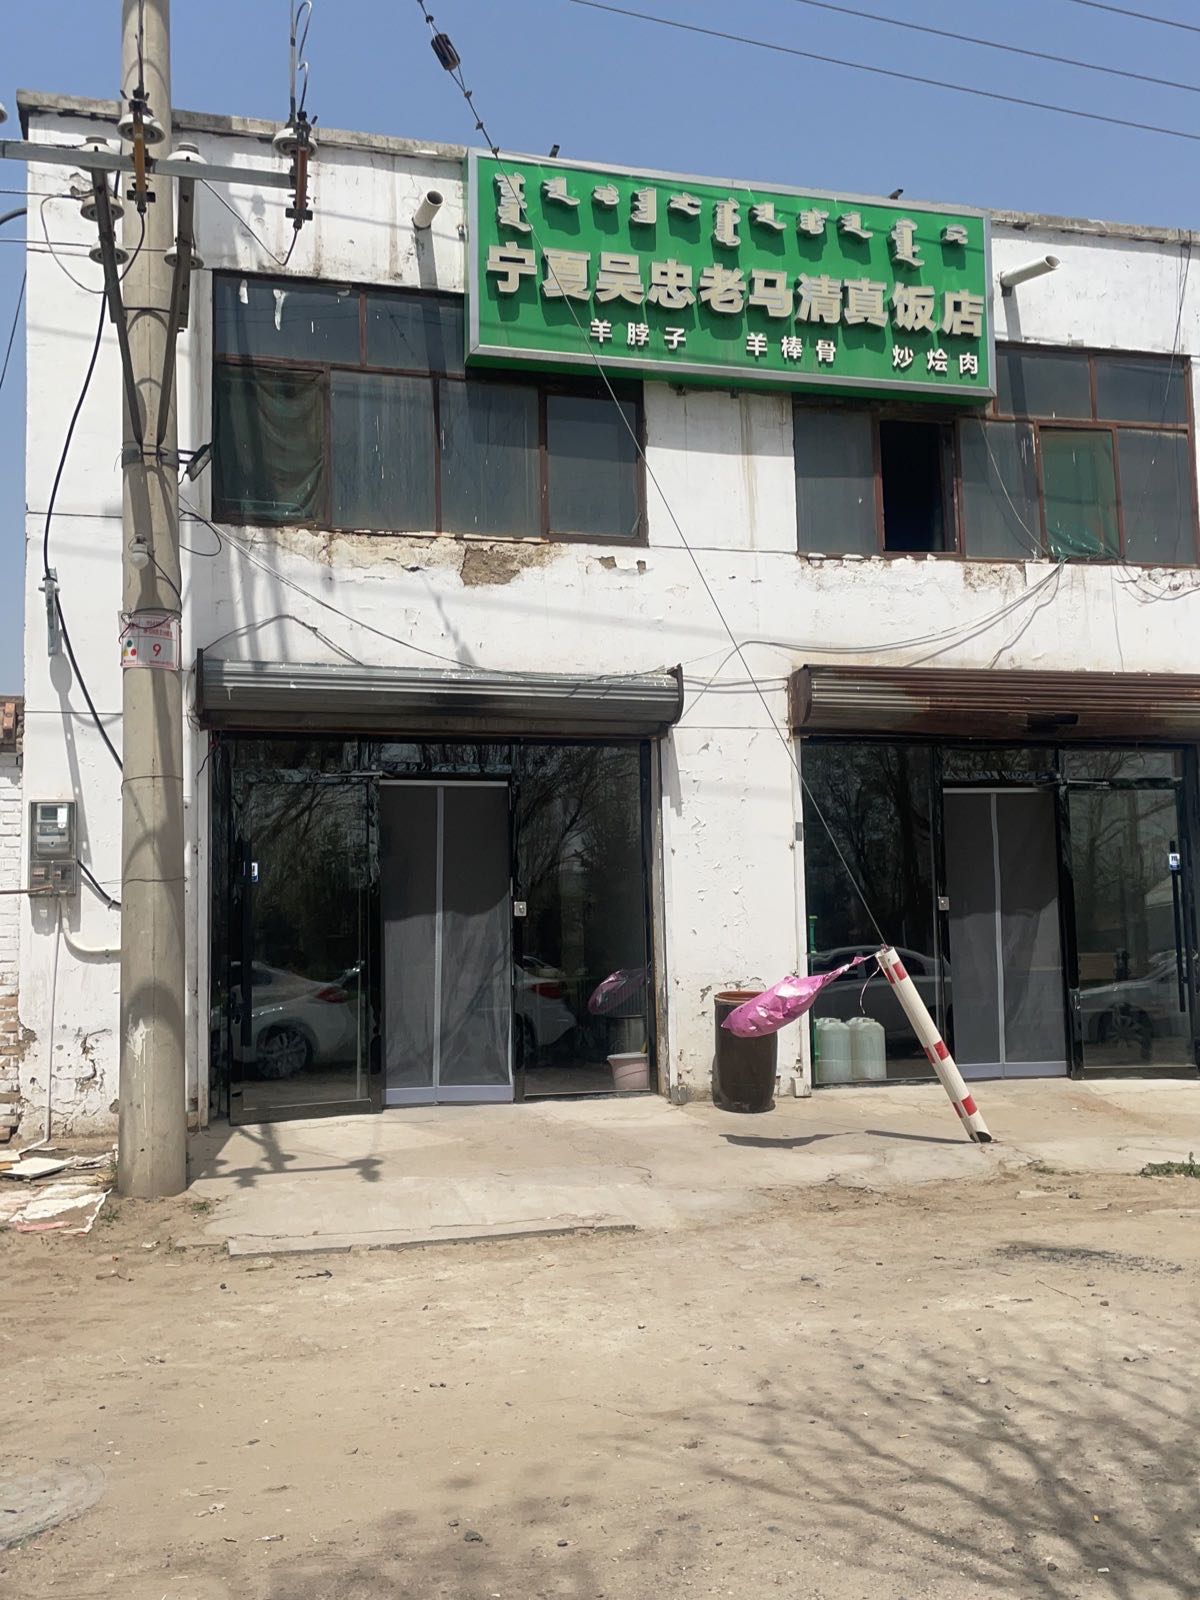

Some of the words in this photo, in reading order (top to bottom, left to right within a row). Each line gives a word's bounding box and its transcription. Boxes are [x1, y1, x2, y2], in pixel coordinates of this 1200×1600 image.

[486, 241, 985, 338] 宁夏吴忠老马清真饭店
[589, 318, 687, 349] 羊脖子
[746, 332, 836, 363] 羊棒骨
[892, 344, 979, 375] 炒烩肉
[153, 643, 162, 656] 9
